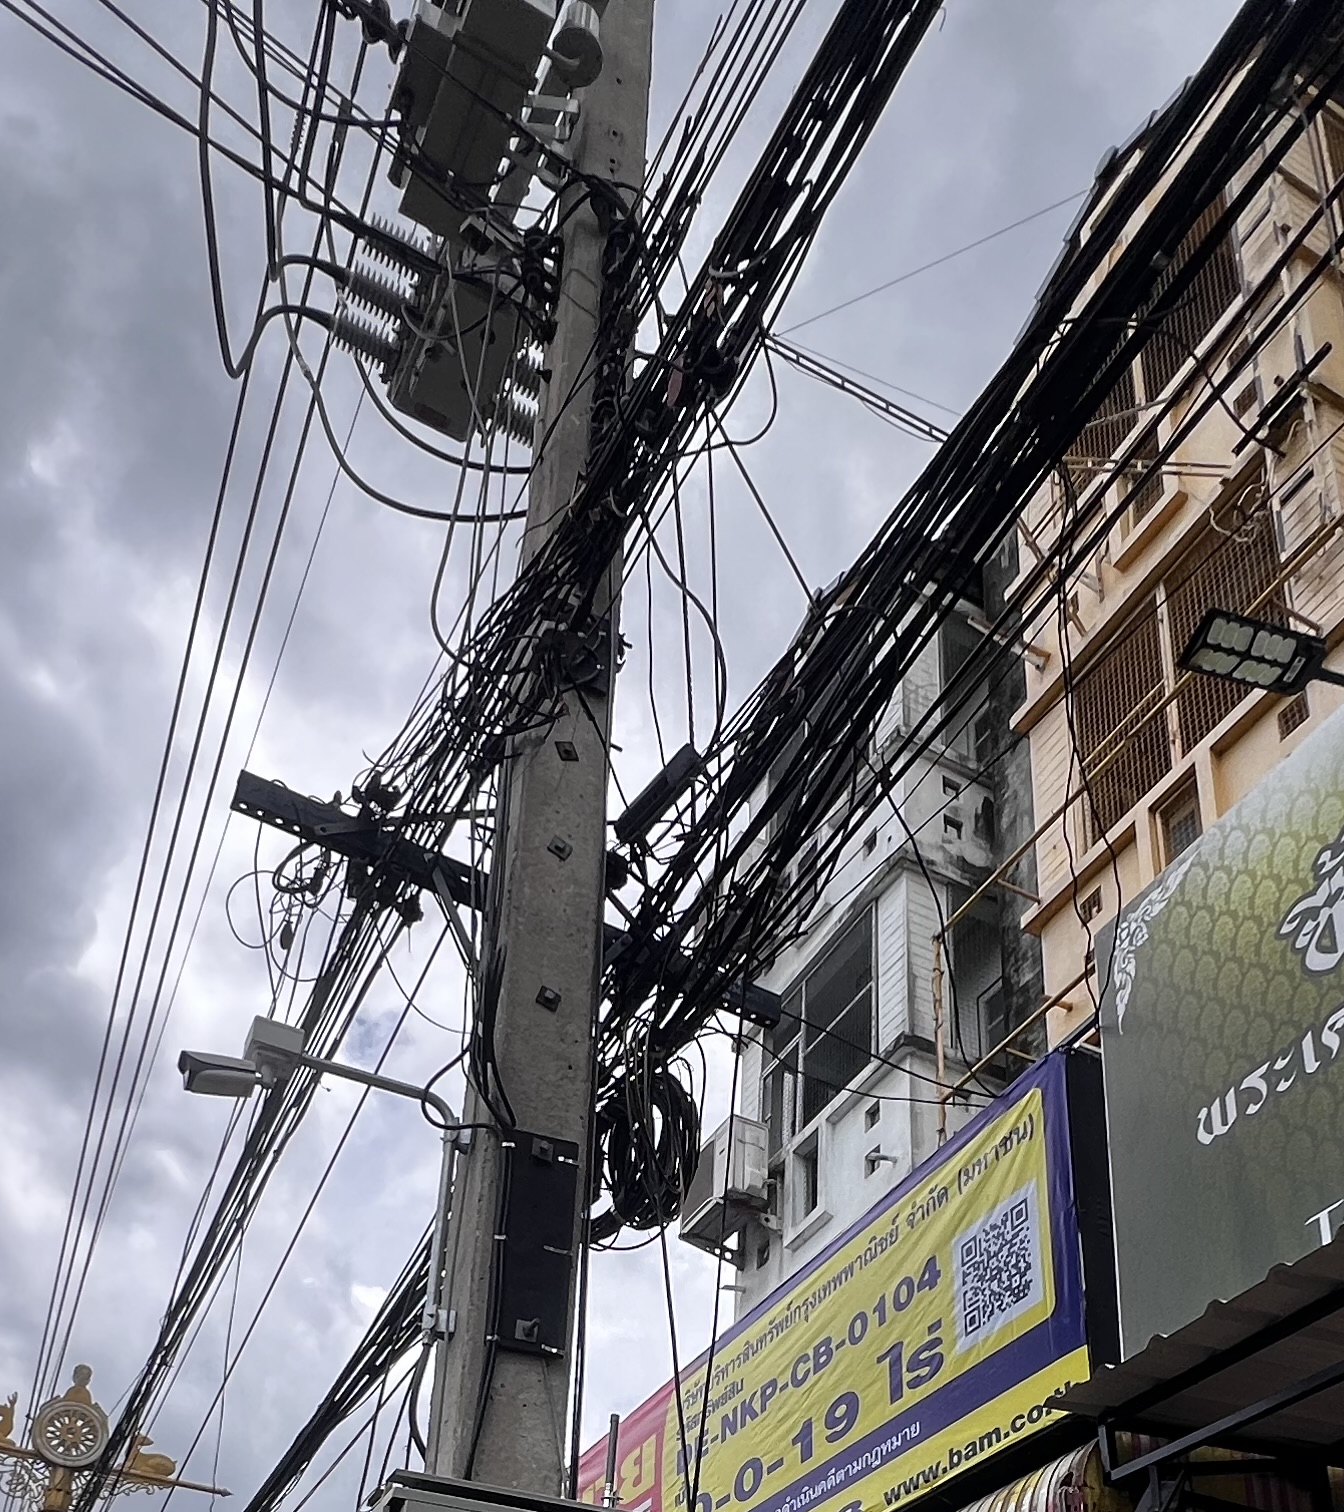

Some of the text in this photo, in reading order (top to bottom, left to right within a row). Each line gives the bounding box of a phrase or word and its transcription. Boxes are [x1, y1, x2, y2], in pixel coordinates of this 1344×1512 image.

[906, 1182, 949, 1231] จำกัด
[957, 1112, 1036, 1196] (มหาชน)
[676, 1254, 942, 1476] DE-NKP-CB-0104
[876, 1317, 945, 1406] ไร่
[883, 1380, 1072, 1506] www.bam.co.
